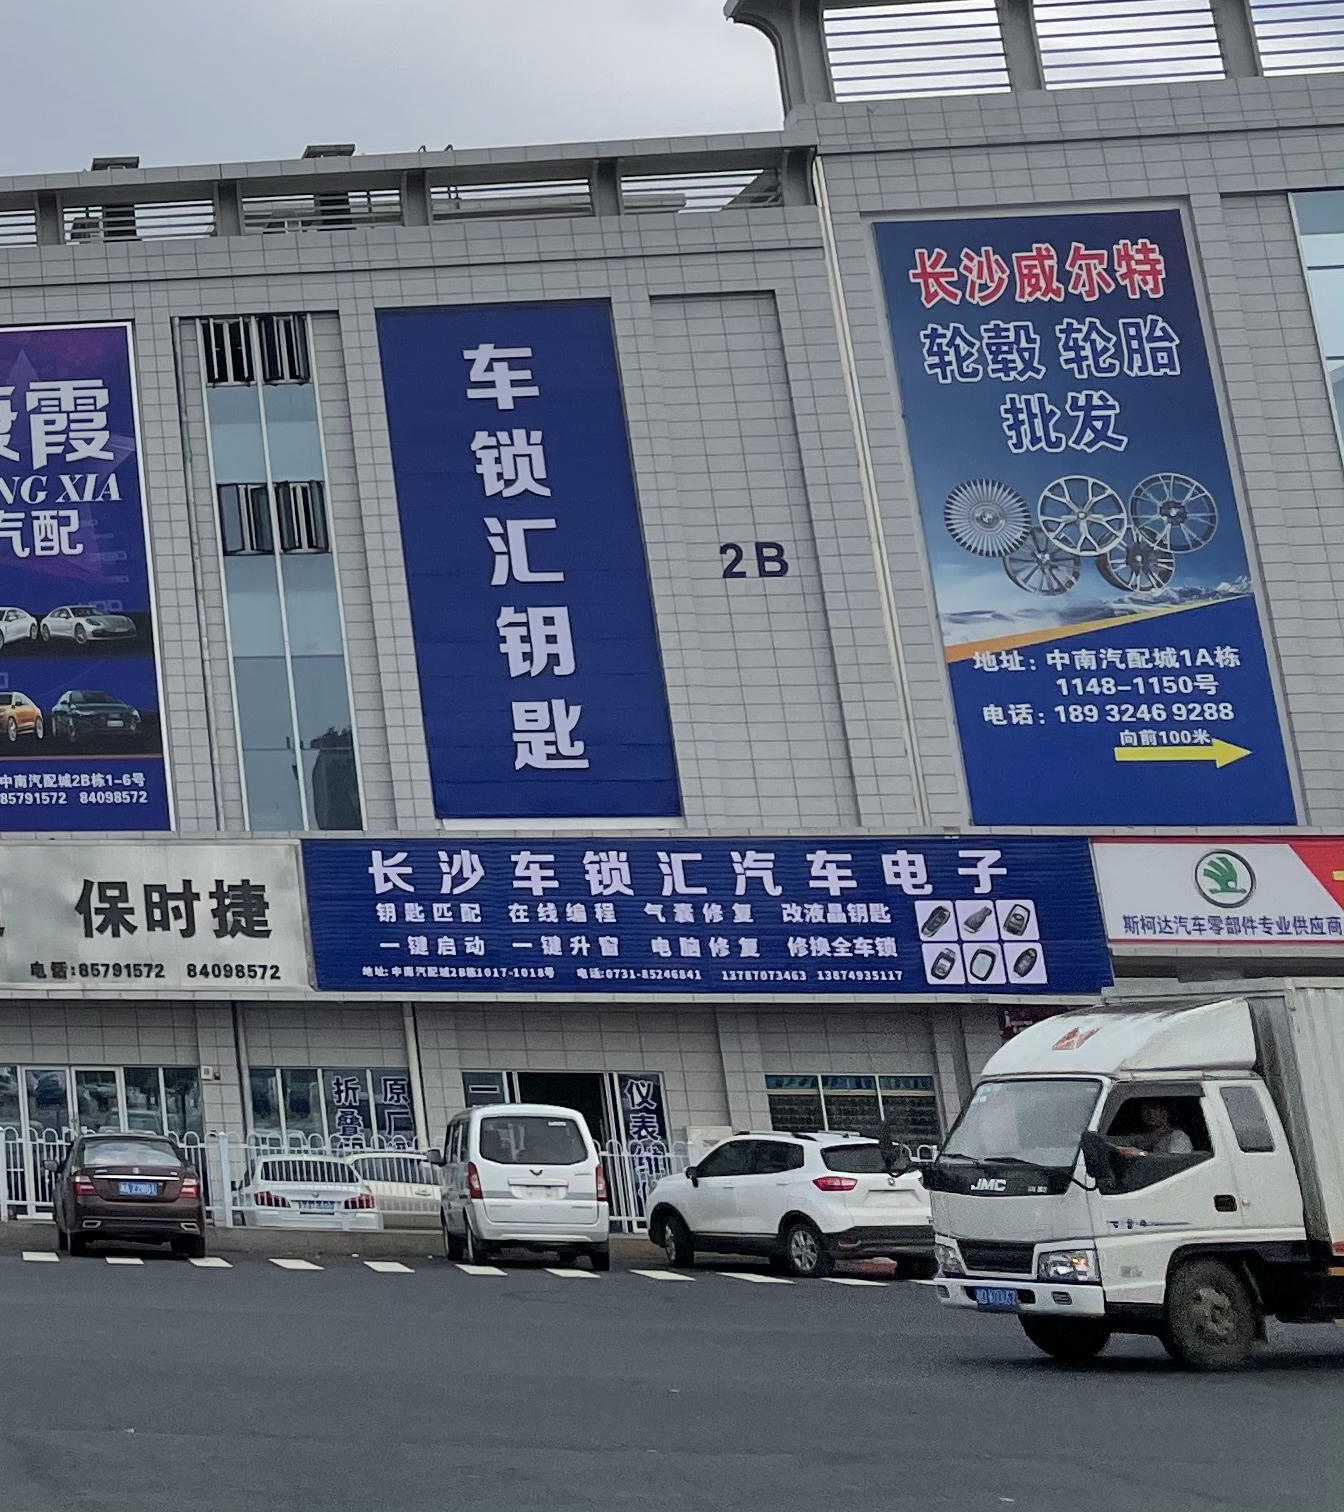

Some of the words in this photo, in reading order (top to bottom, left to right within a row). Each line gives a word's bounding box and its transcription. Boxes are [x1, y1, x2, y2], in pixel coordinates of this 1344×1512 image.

[910, 238, 1165, 308] 长沙威尔特
[920, 320, 1047, 384] 轮毂
[1056, 314, 1182, 380] 轮胎
[1000, 389, 1130, 453] 批发
[53, 471, 123, 504] XIA
[462, 343, 591, 771] 车锁汇钥匙
[718, 541, 790, 580] 2B
[79, 789, 149, 807] 84098572
[368, 848, 1008, 896] 长沙车锁汇汽车电子
[73, 877, 274, 939] 保时捷
[507, 902, 618, 925] 在线编程
[1122, 914, 1344, 937] 斯柯达汽车零部件专业供应商
[378, 934, 486, 957] 一键启动
[650, 935, 761, 958] 电脑修复
[185, 961, 282, 981] 84098572
[970, 1177, 1007, 1192] JMC
